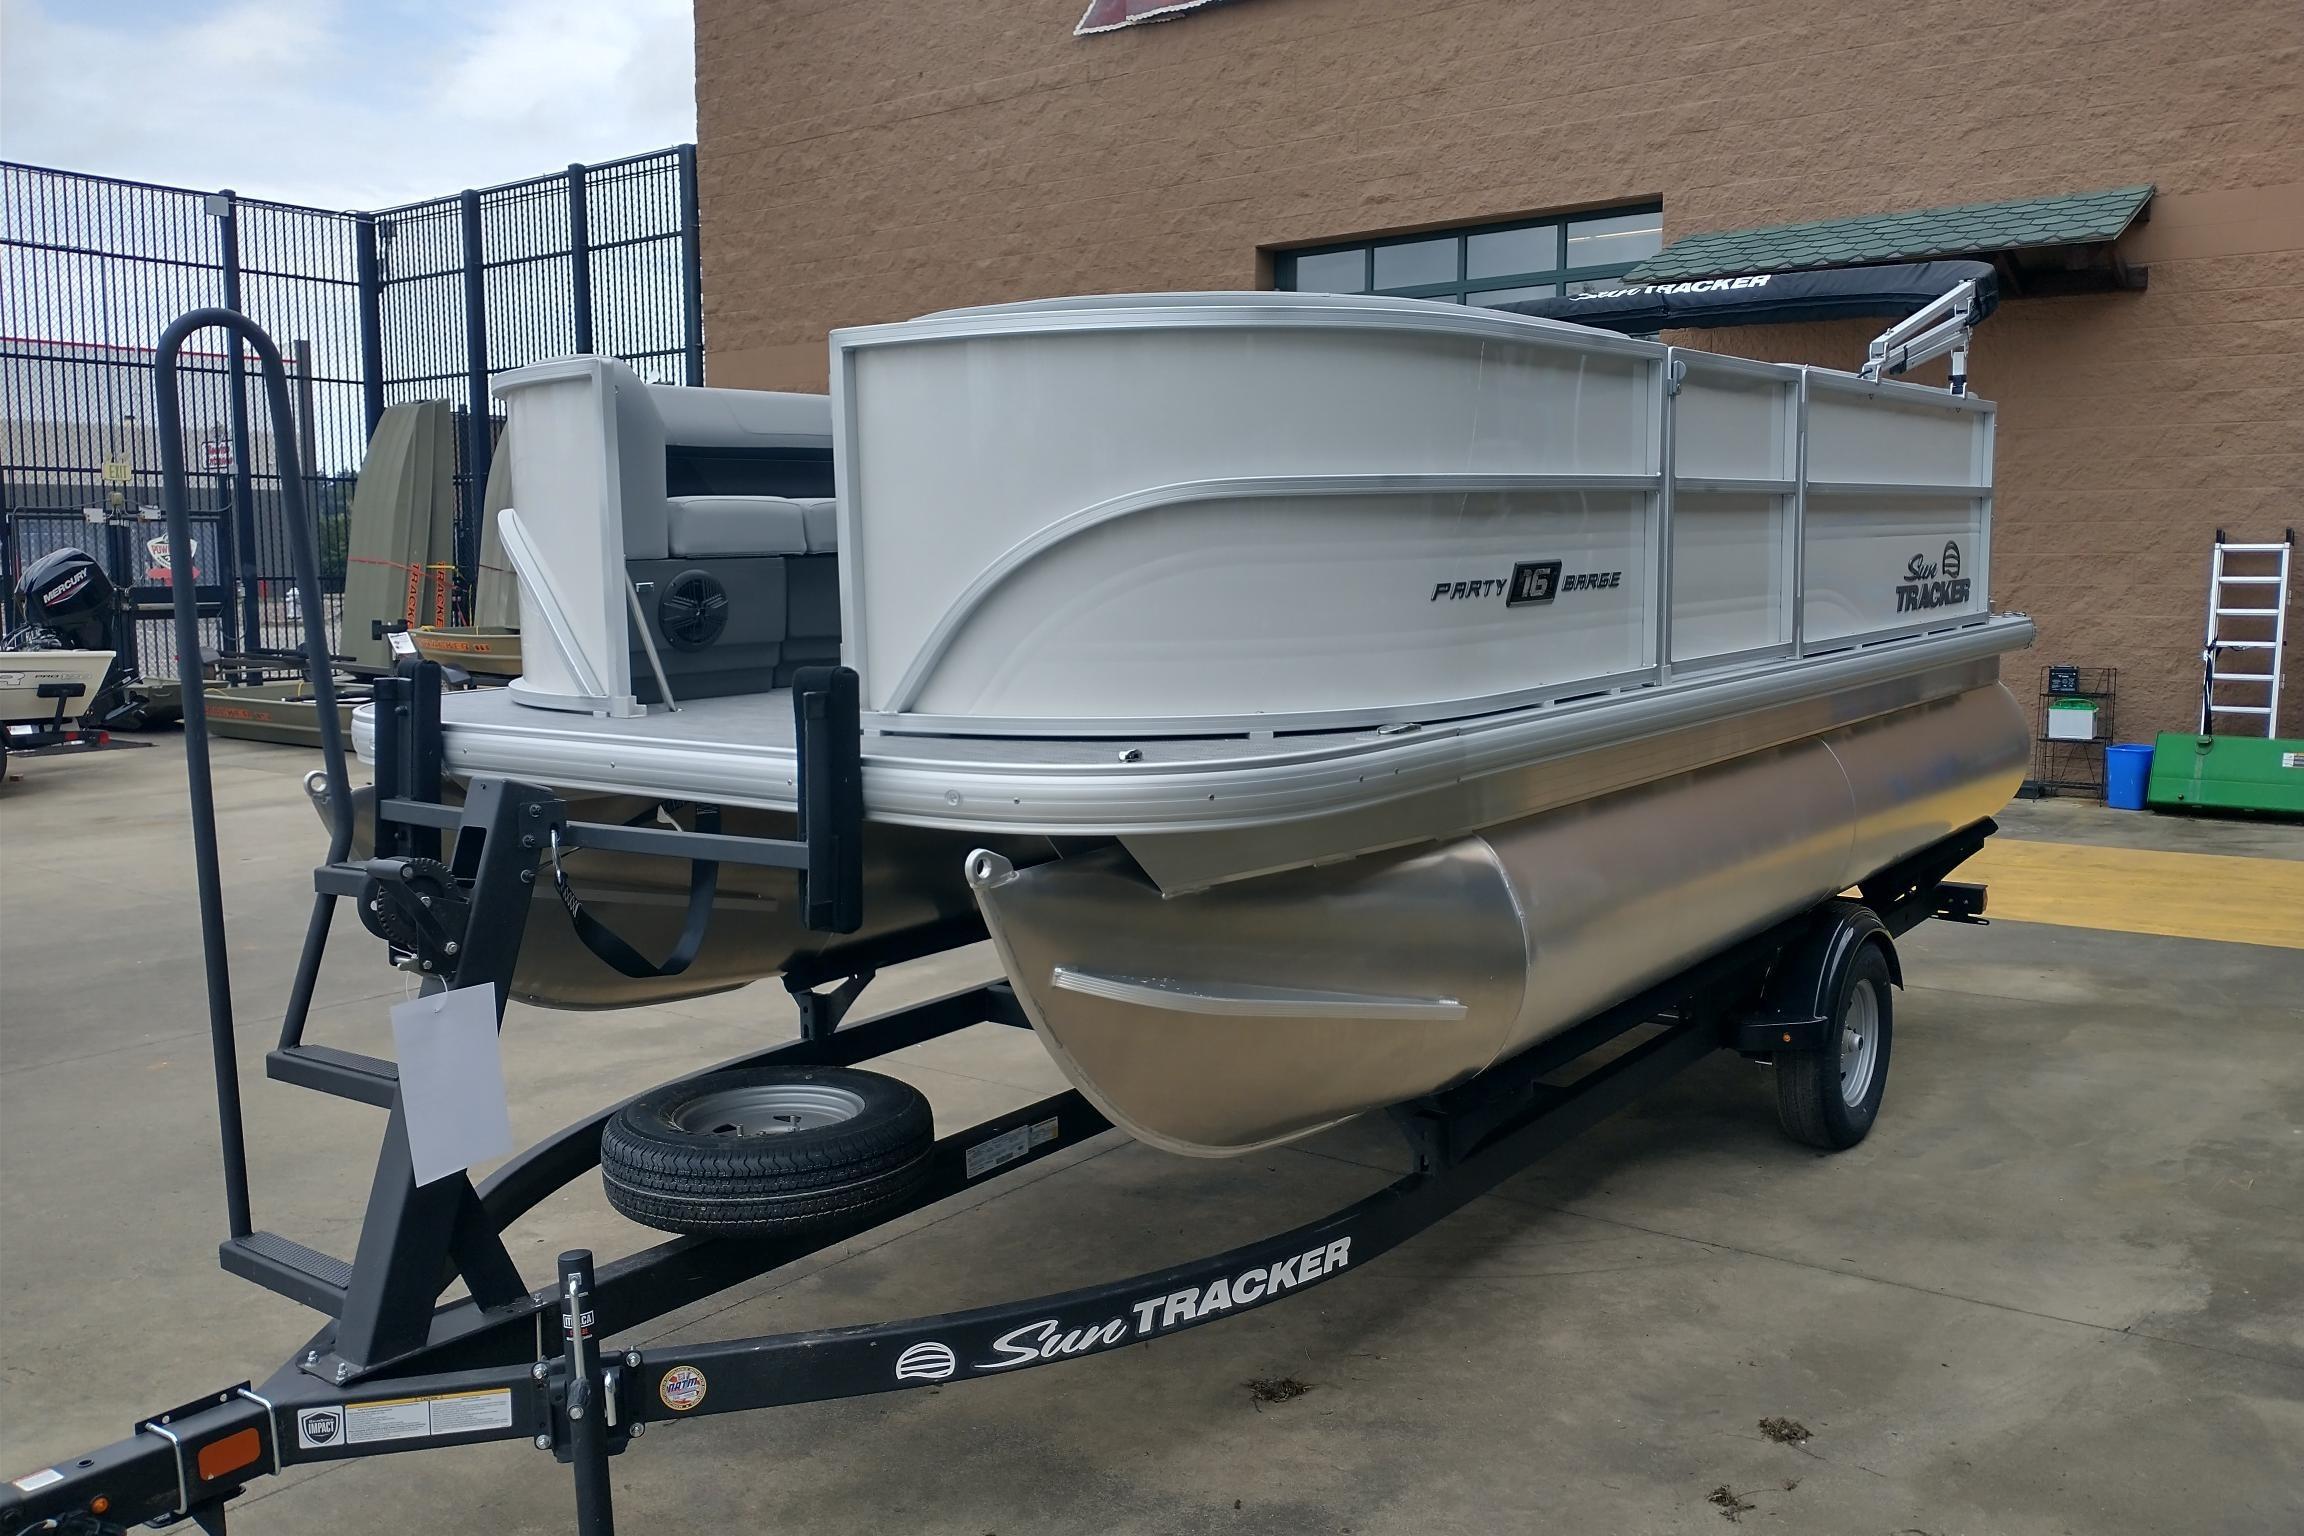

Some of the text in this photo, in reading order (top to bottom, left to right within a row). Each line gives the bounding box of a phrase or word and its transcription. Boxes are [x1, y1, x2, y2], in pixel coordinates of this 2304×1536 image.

[1645, 275, 1771, 294] TRACKER
[109, 465, 127, 478] EXIT
[1904, 553, 1937, 582] Sun
[43, 567, 88, 604] MERCURY
[436, 561, 445, 627] TRACKE
[1431, 568, 1622, 601] PARTY 16 BARGE
[1896, 578, 1971, 614] TRACKER
[974, 1236, 1352, 1369] Sun TRACKER
[565, 1314, 592, 1327] ITCA
[308, 1421, 335, 1435] IMPACT
